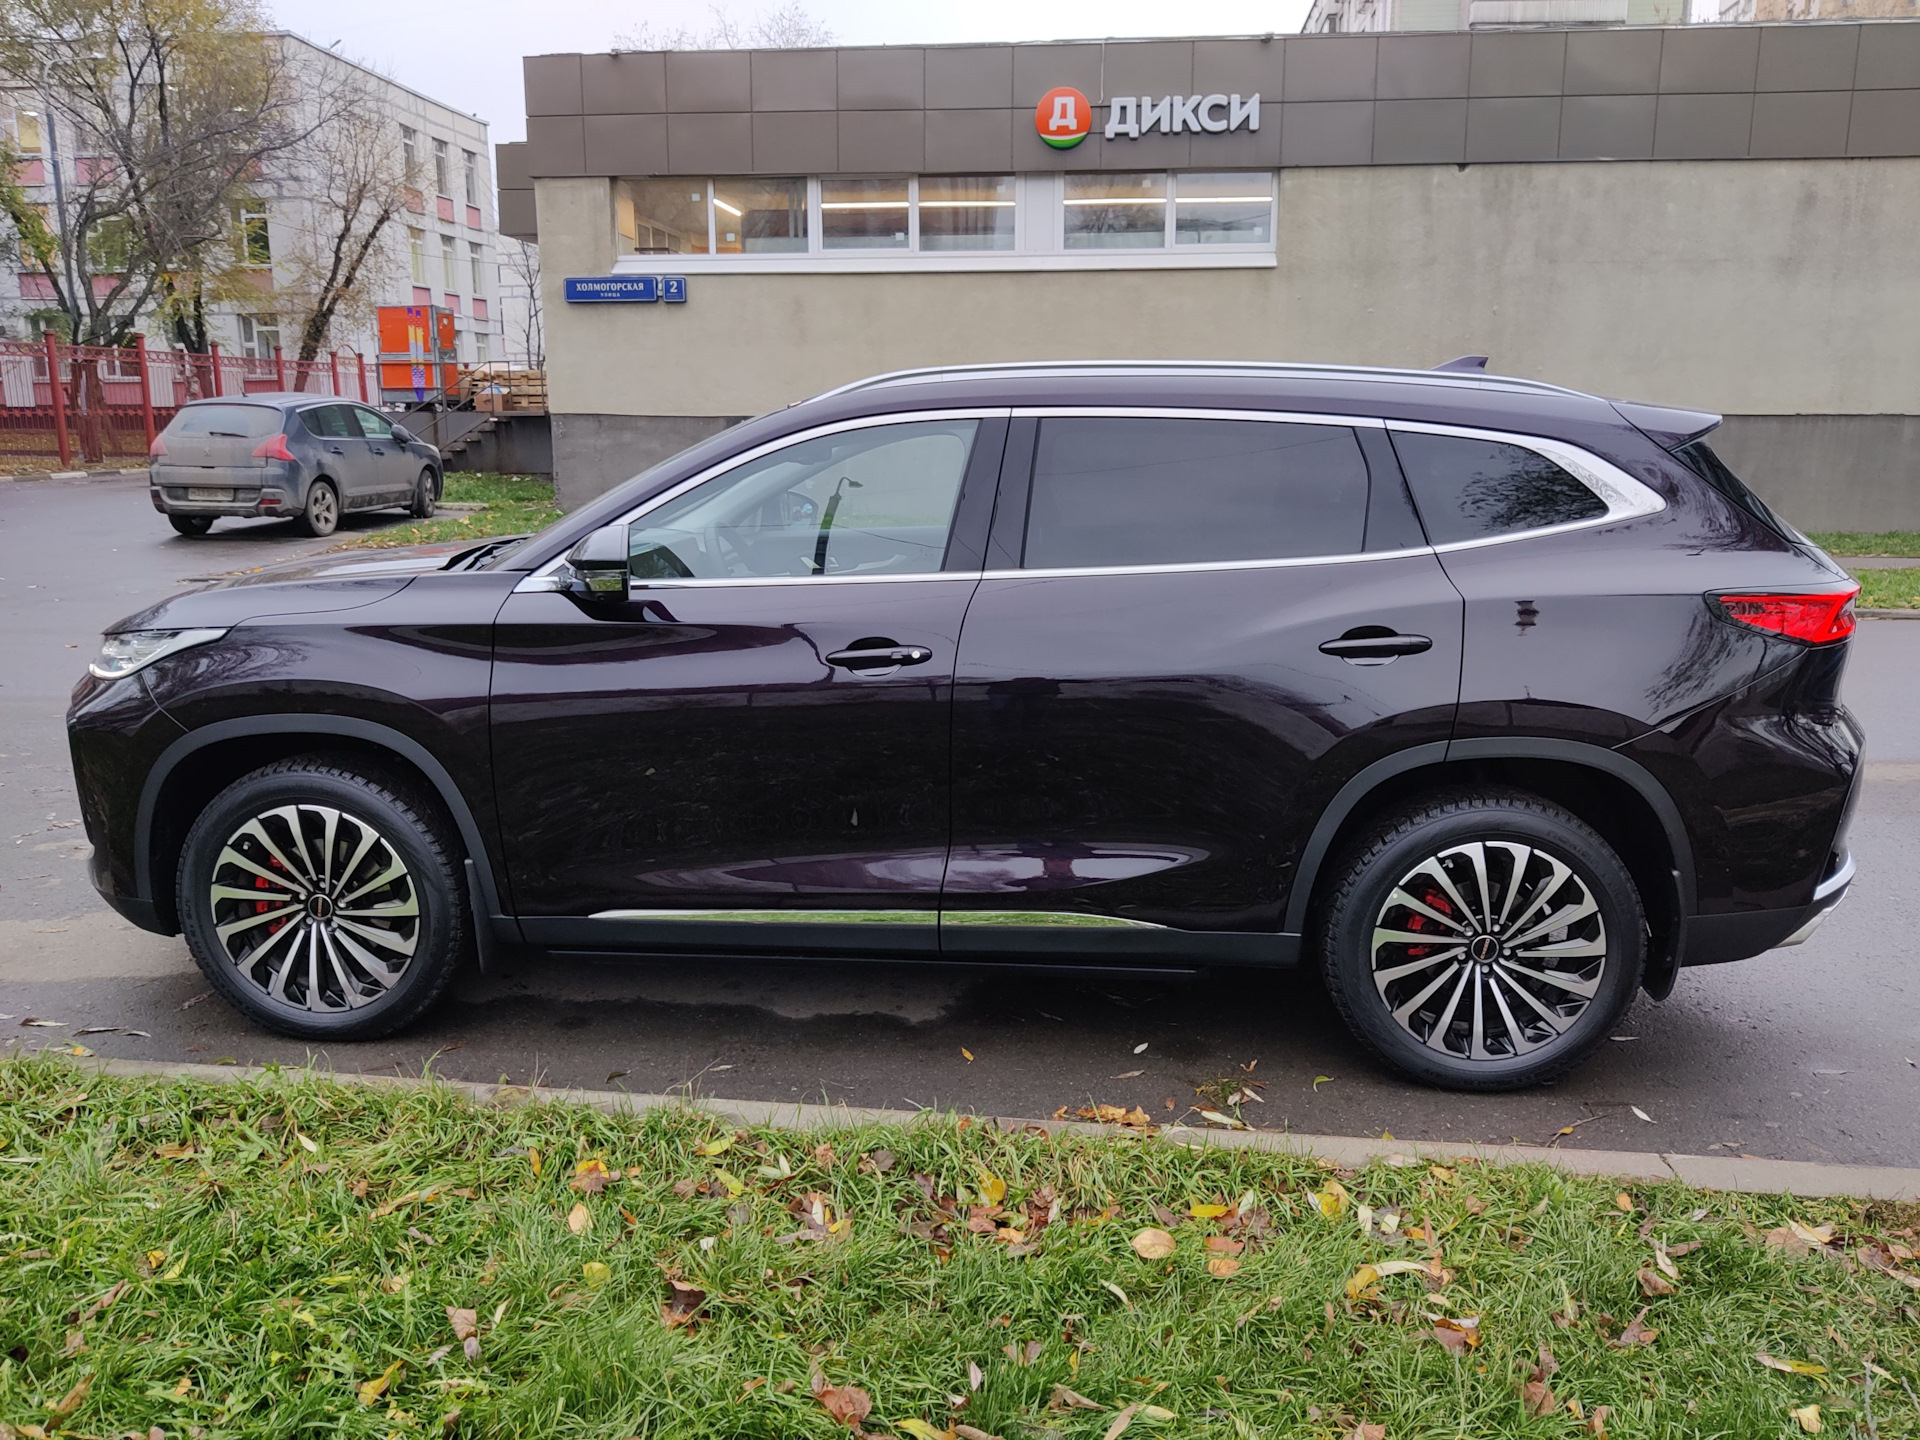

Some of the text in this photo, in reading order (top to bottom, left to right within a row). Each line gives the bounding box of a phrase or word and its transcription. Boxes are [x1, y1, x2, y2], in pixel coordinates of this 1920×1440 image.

[1049, 92, 1260, 140] Д ДИКСИ
[576, 282, 644, 292] ХОЛМОГОРСКАЯ
[669, 281, 678, 293] 2
